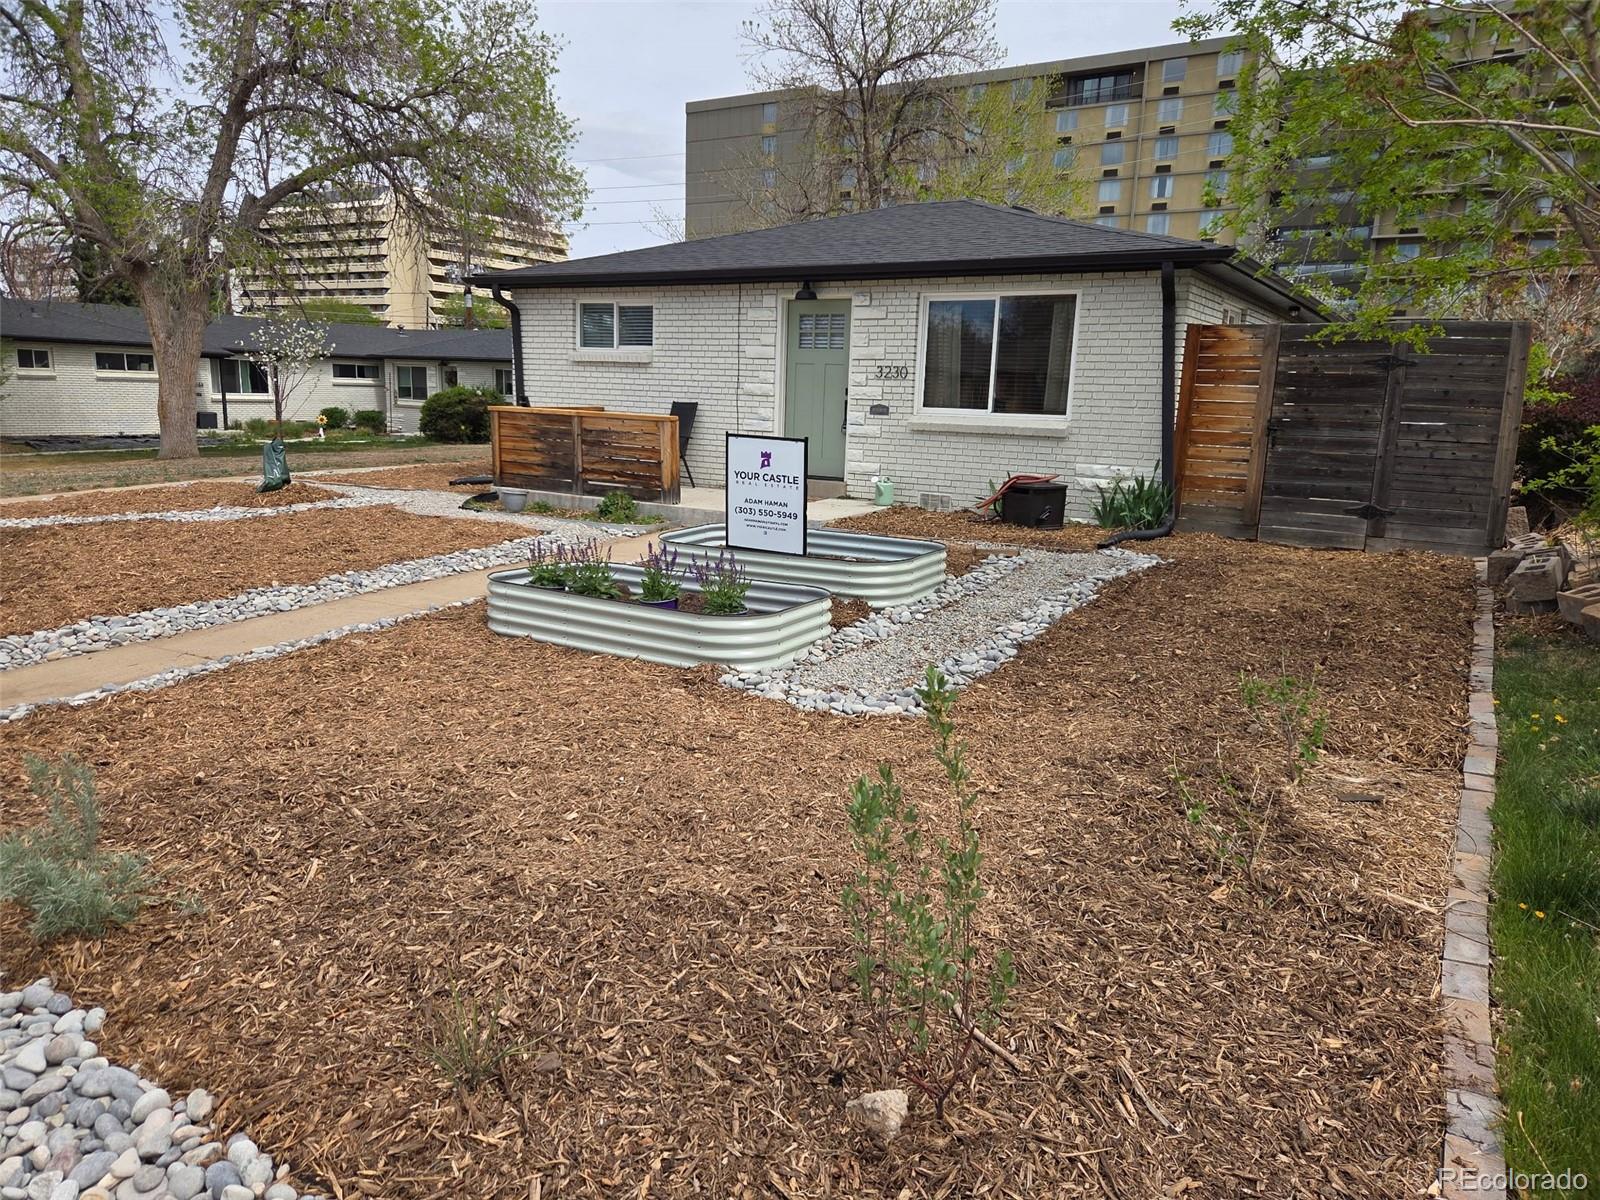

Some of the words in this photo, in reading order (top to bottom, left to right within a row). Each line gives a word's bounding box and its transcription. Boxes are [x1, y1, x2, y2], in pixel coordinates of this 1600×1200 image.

[875, 366, 908, 379] 3230
[734, 470, 760, 481] YOUR
[762, 473, 799, 484] CASTLE
[734, 506, 756, 516] (303)
[758, 508, 798, 520] 550-5949
